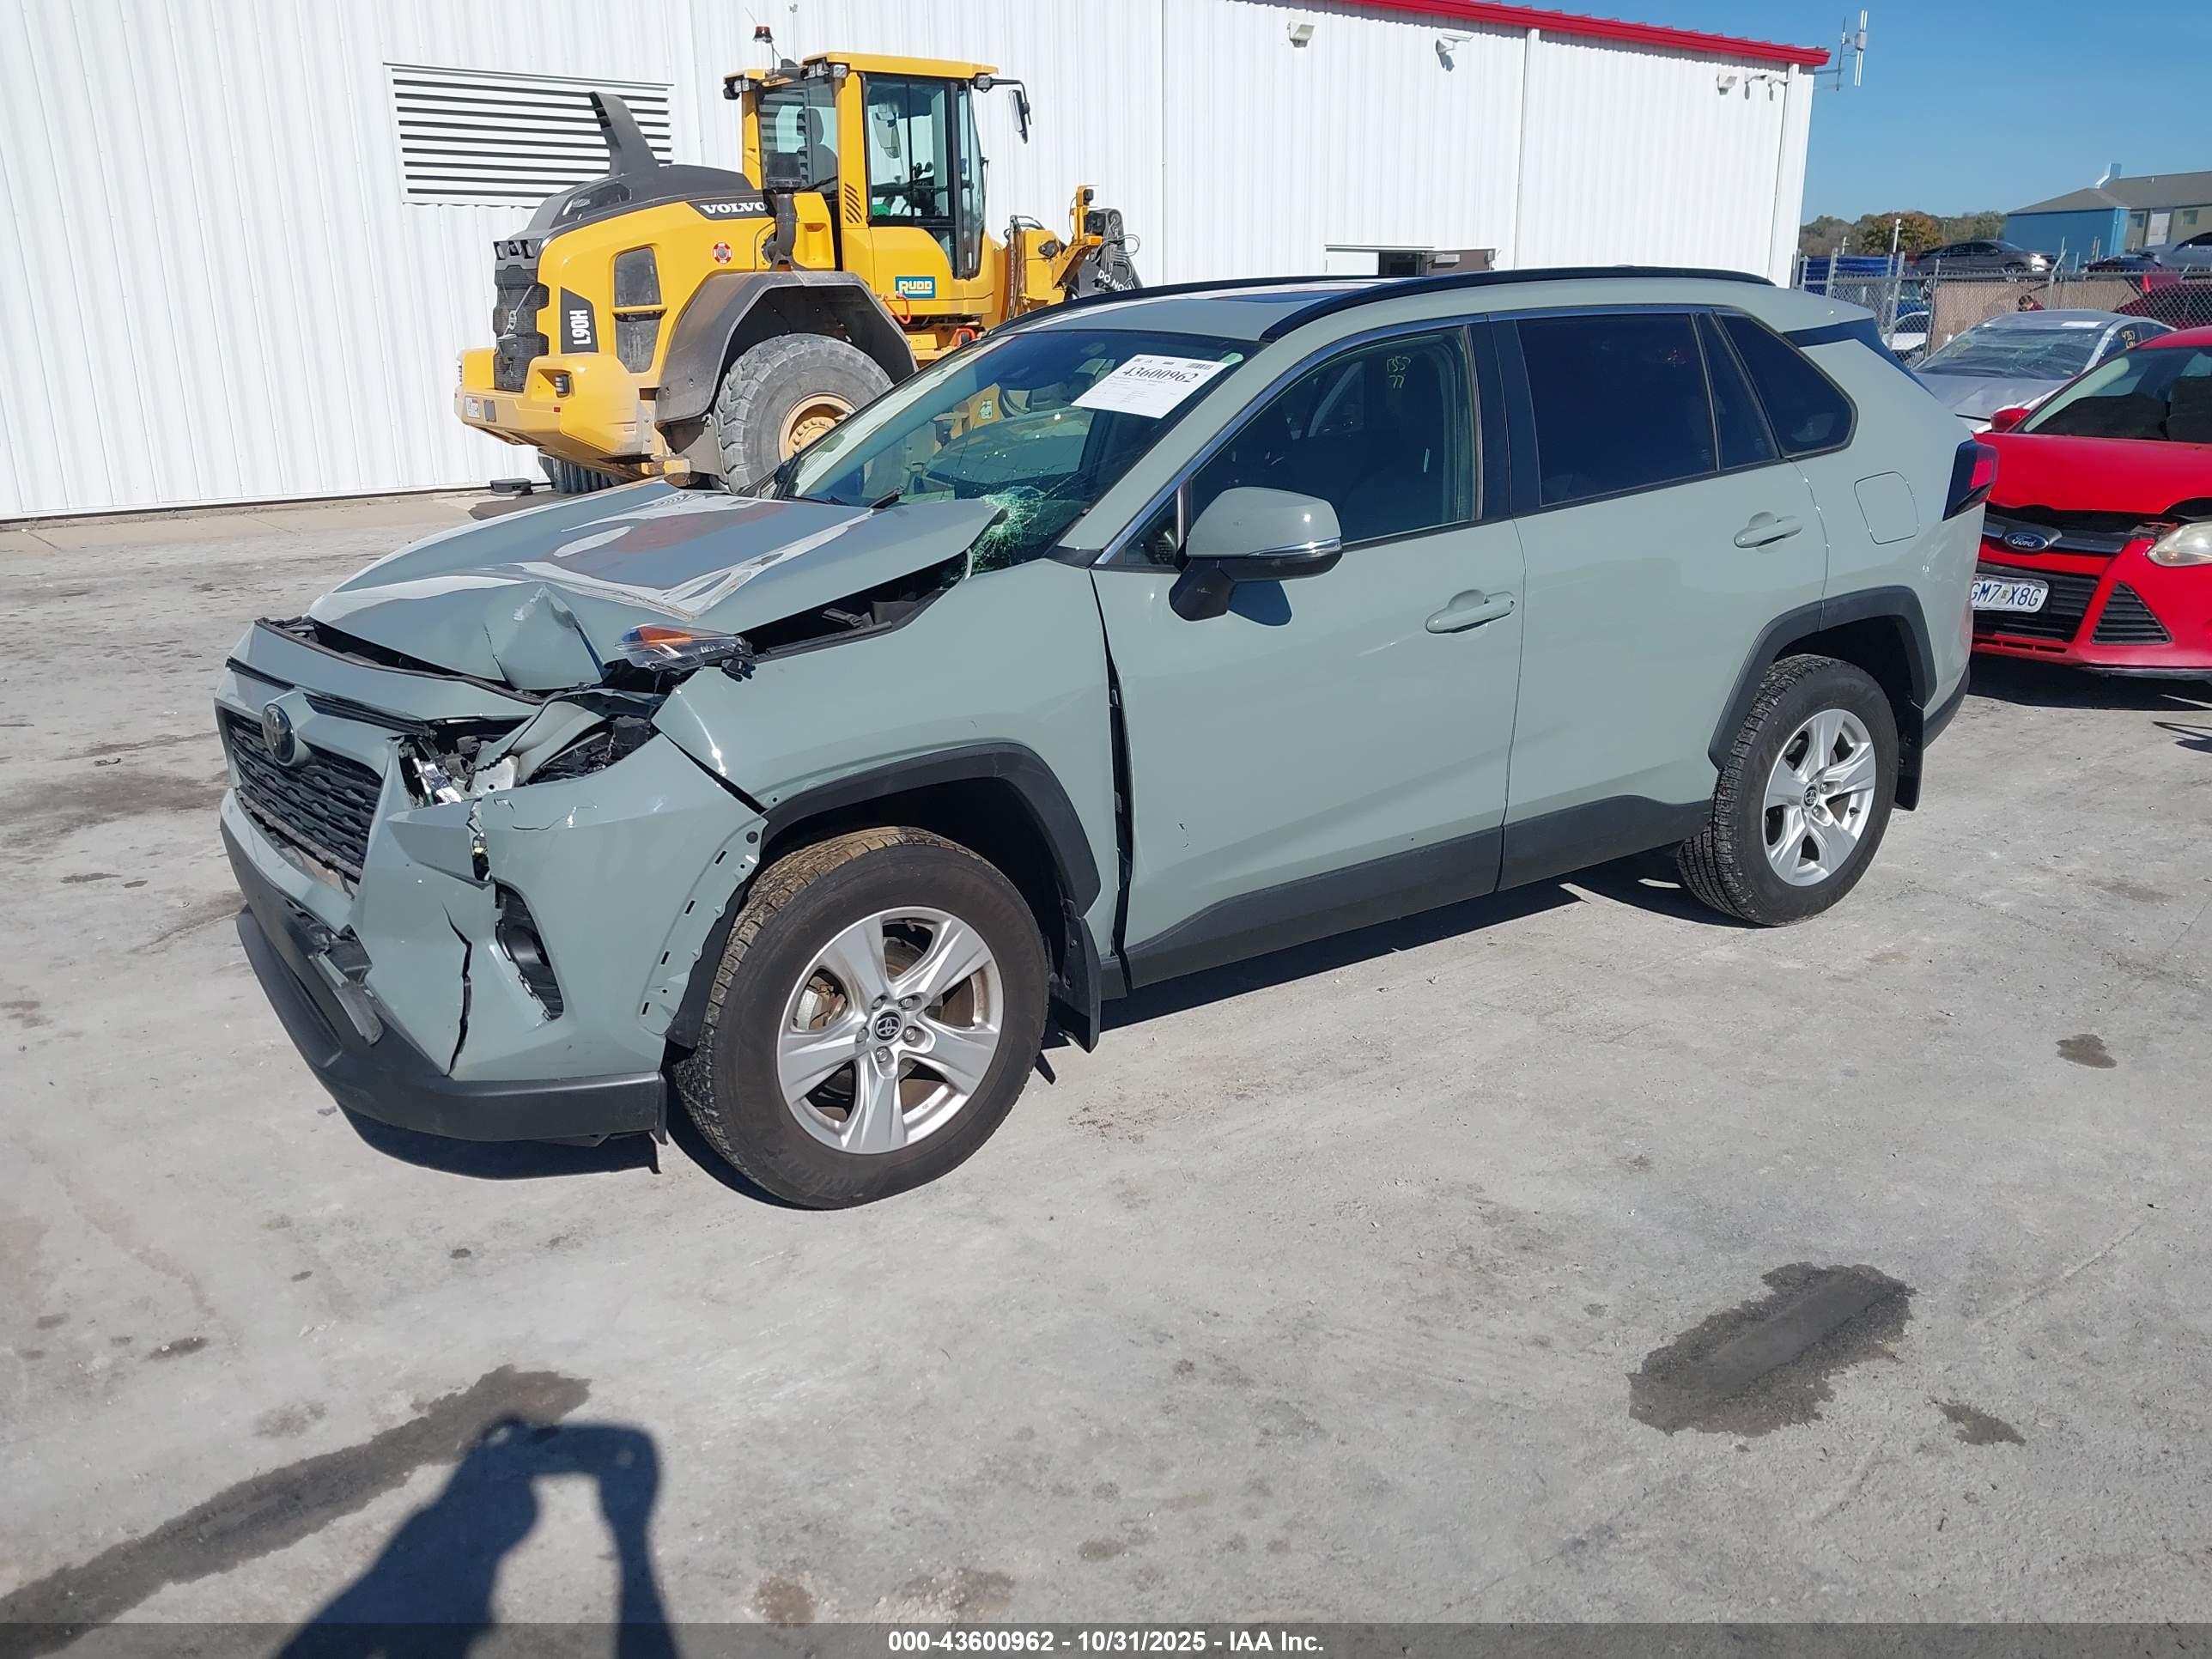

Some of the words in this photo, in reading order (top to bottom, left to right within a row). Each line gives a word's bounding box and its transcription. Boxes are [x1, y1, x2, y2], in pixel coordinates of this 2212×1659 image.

[700, 201, 767, 214] VOLVO
[1097, 269, 1111, 283] DO
[898, 280, 933, 294] RUDD
[569, 309, 592, 344] L90H
[1122, 366, 1200, 383] 43600962
[2012, 535, 2035, 547] Ford
[1971, 582, 2002, 602] GM7
[2006, 586, 2042, 606] X8G
